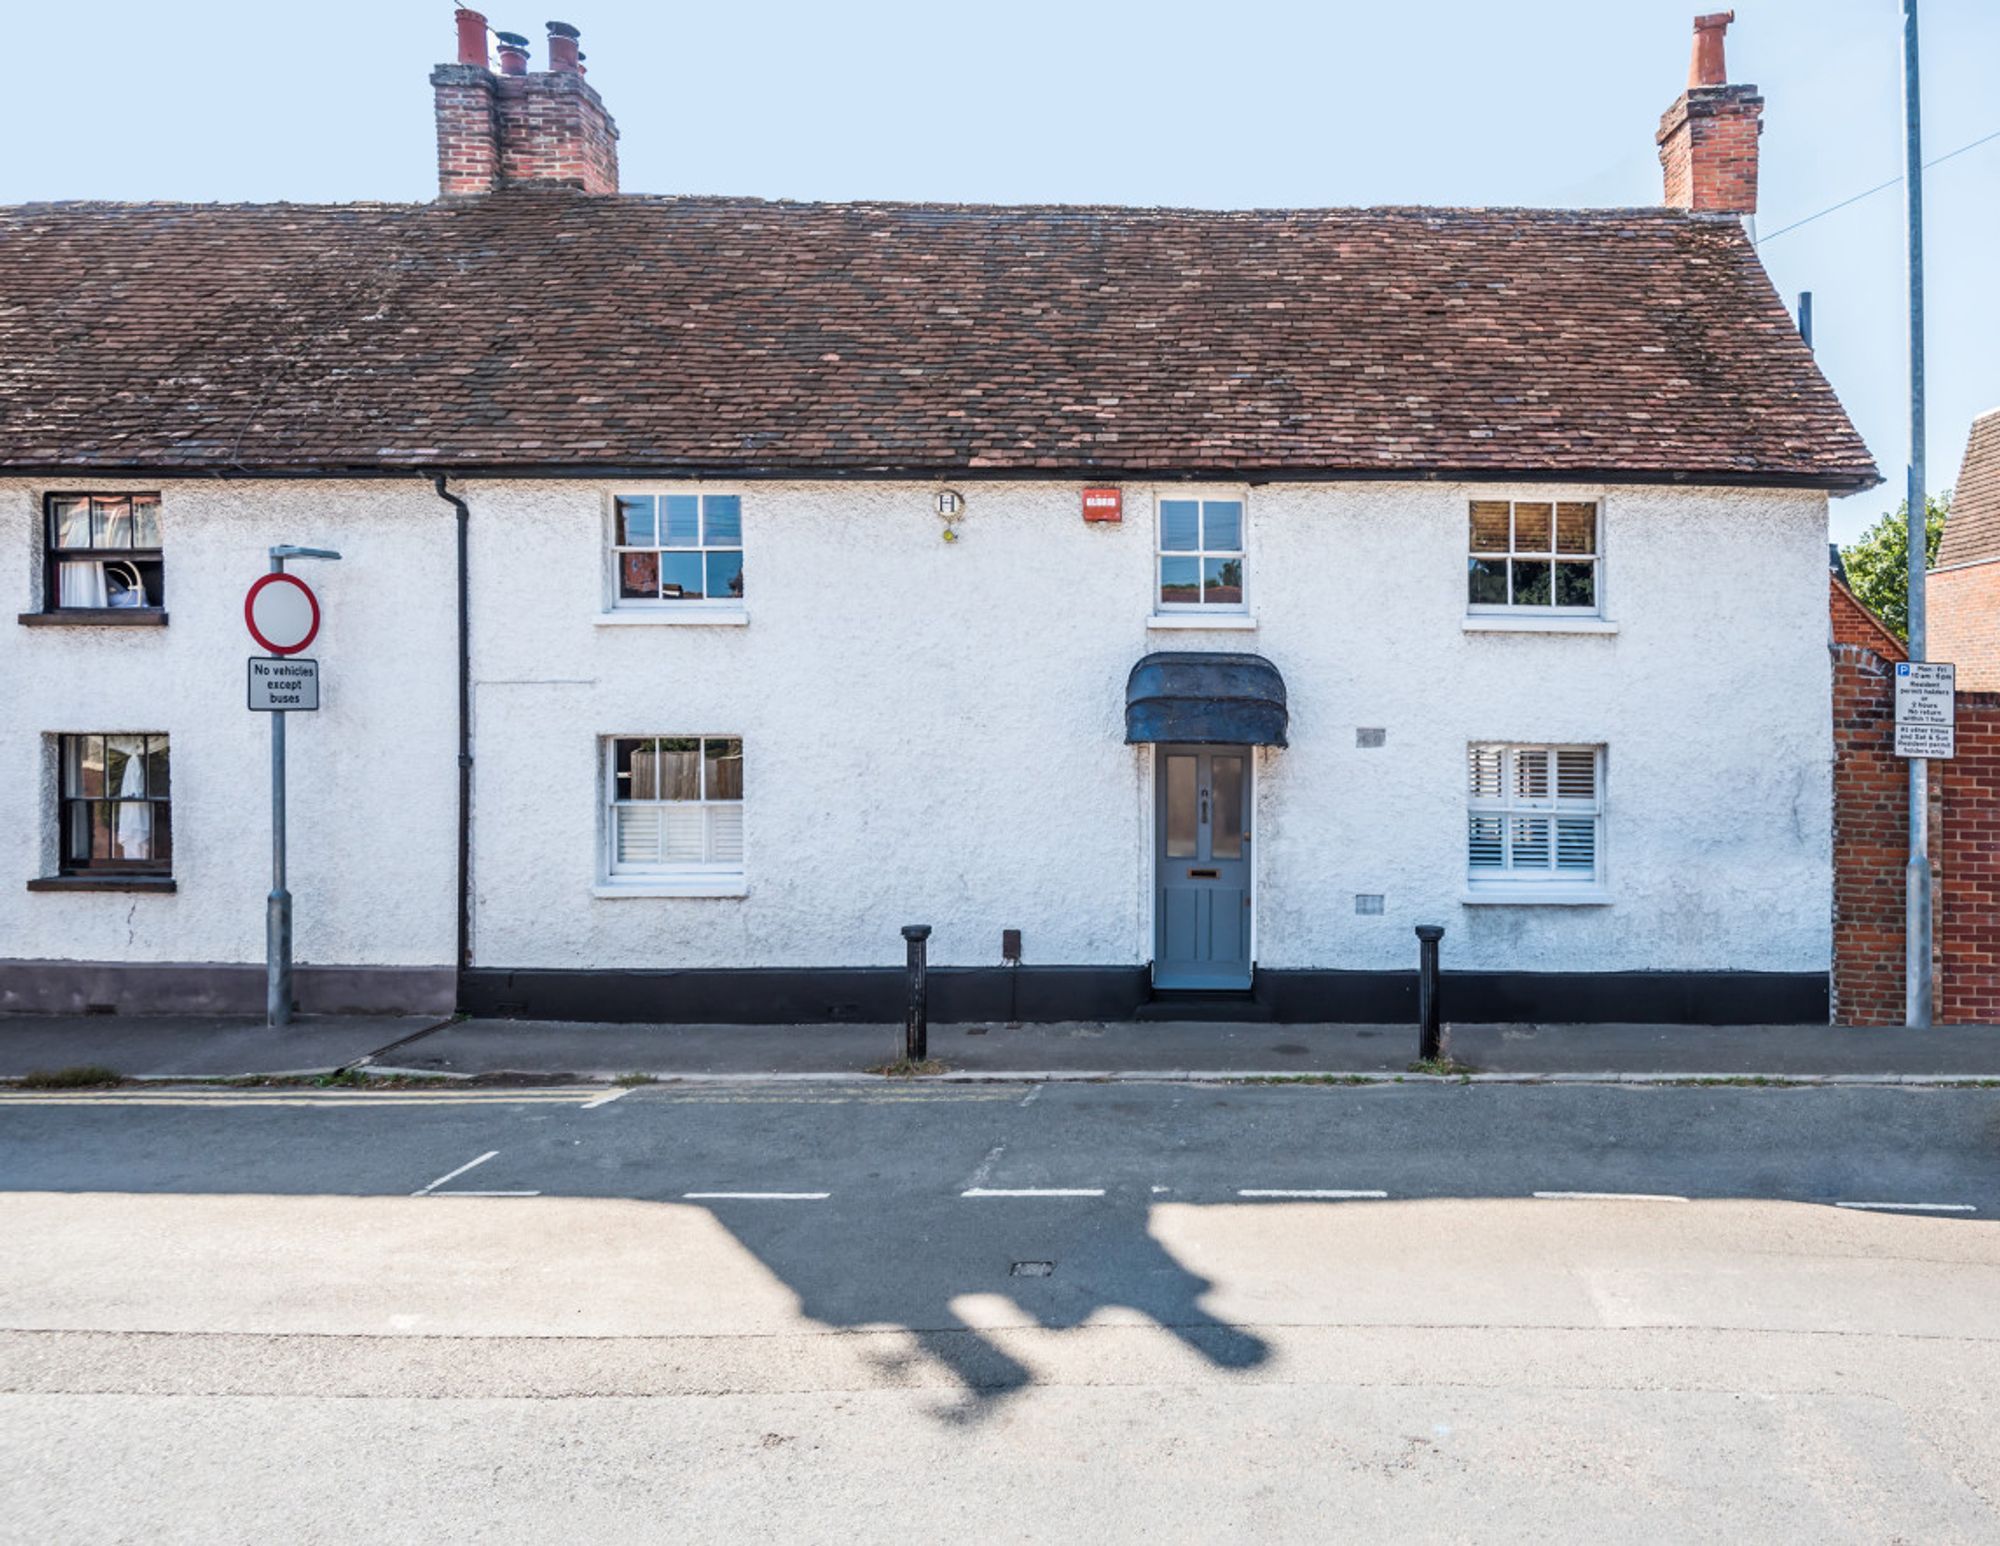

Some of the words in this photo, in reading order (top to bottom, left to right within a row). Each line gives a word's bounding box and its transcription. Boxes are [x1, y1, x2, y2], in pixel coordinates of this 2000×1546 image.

[254, 664, 270, 675] No
[273, 665, 314, 677] vehicles
[1900, 664, 1908, 675] P
[267, 680, 302, 691] except
[270, 693, 300, 704] buses
[1918, 701, 1938, 709] hours
[1898, 739, 1928, 747] Resident
